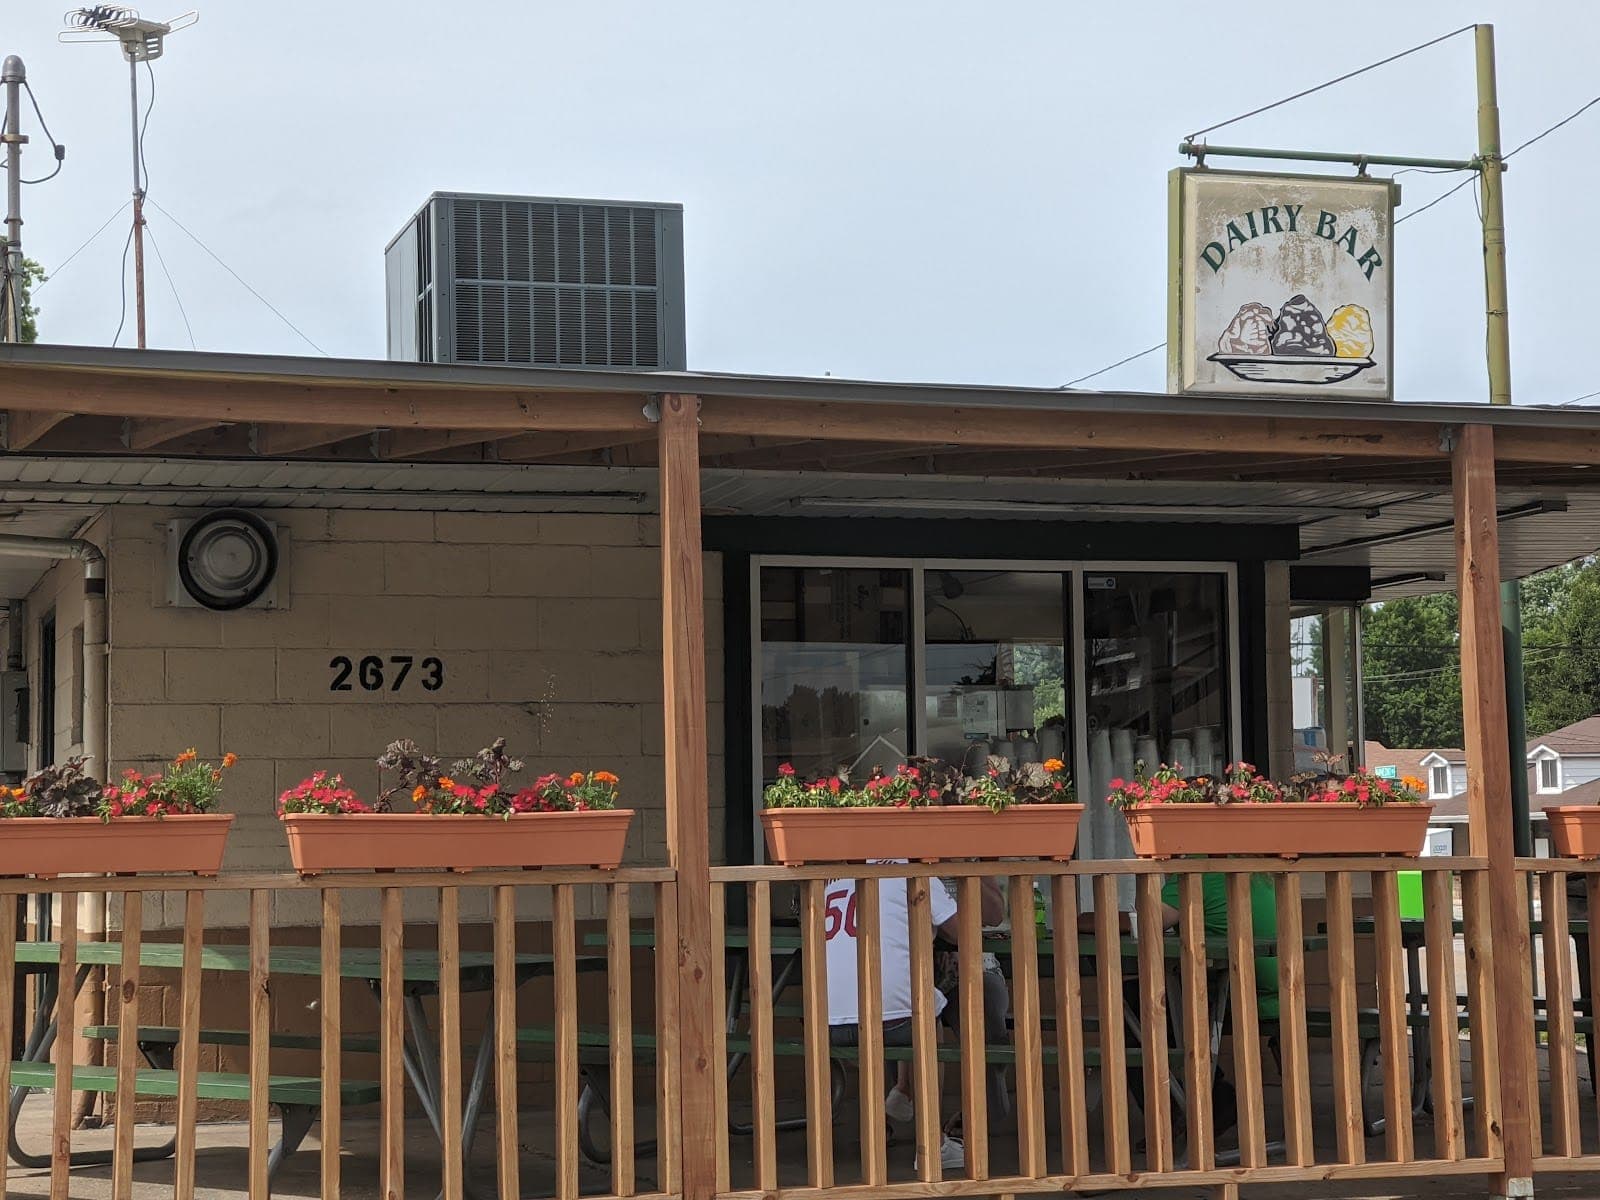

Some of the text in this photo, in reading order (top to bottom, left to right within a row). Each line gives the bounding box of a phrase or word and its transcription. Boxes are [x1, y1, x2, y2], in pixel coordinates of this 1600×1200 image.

[1201, 204, 1382, 281] DAIRY BAR
[329, 655, 443, 691] 2673
